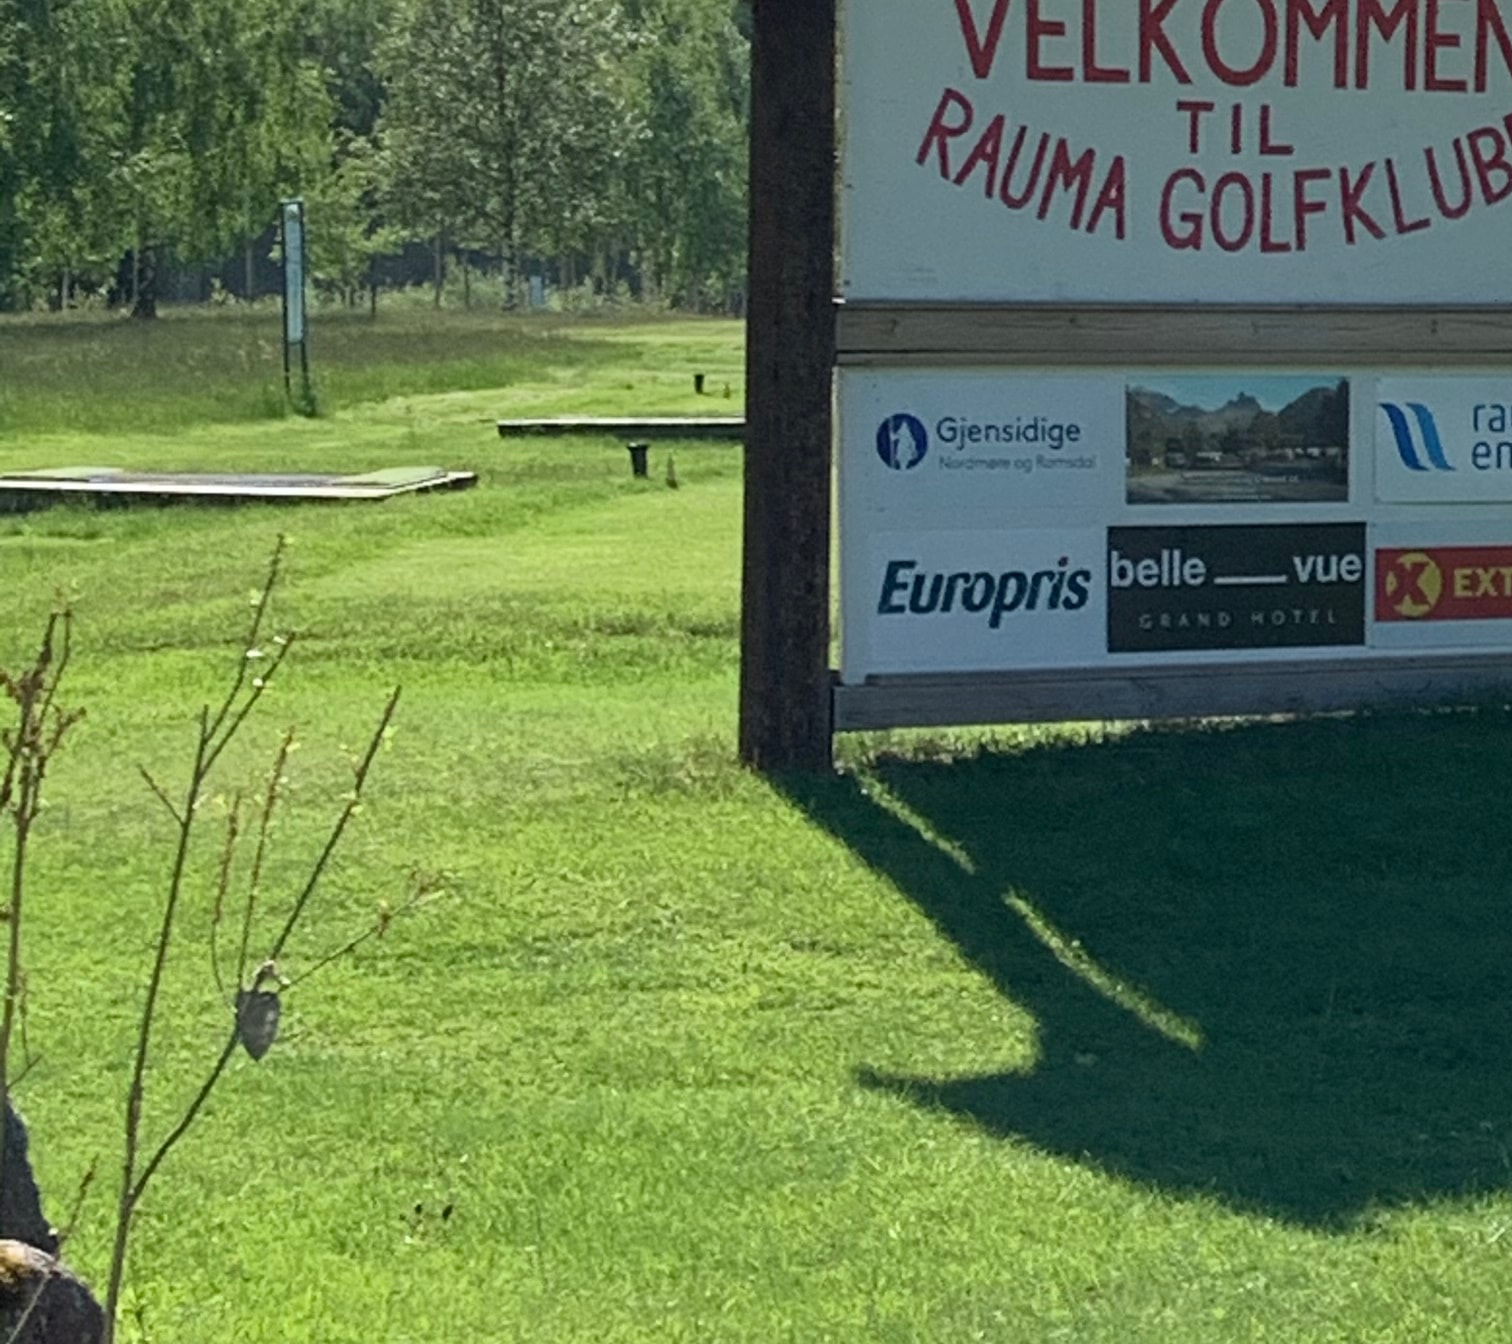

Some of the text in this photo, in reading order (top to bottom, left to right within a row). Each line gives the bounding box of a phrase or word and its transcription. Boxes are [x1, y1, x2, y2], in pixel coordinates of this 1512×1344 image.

[1176, 100, 1294, 156] TIL
[915, 88, 1126, 240] RAUMA
[937, 416, 1081, 450] Gjensidige
[1110, 550, 1362, 587] belle vue
[877, 556, 1092, 630] Europris
[1138, 609, 1337, 630] GRAND HOTEL
